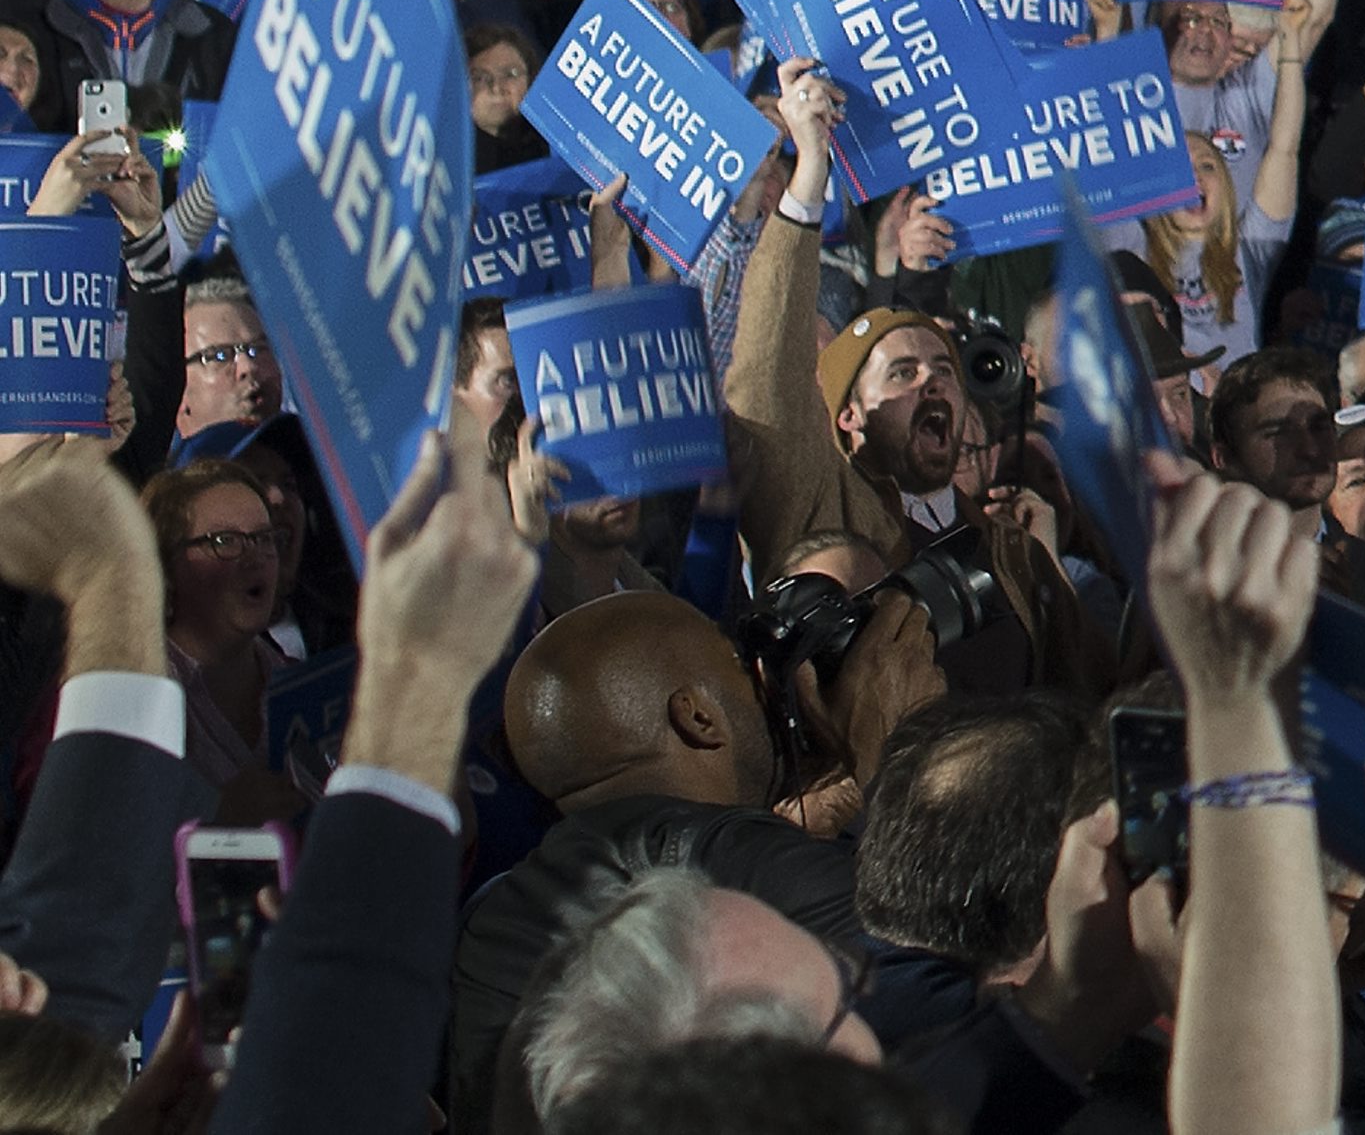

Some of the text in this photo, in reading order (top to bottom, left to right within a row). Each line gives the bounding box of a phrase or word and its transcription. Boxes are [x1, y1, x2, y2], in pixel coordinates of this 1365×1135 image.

[580, 12, 745, 183] A FUTURE TO
[934, 84, 979, 146] TO
[1107, 72, 1166, 110] TO
[556, 39, 728, 221] BELIEVE IN
[891, 106, 944, 172] IN
[926, 109, 1176, 202] BELIEVE IN
[534, 349, 563, 390] A
